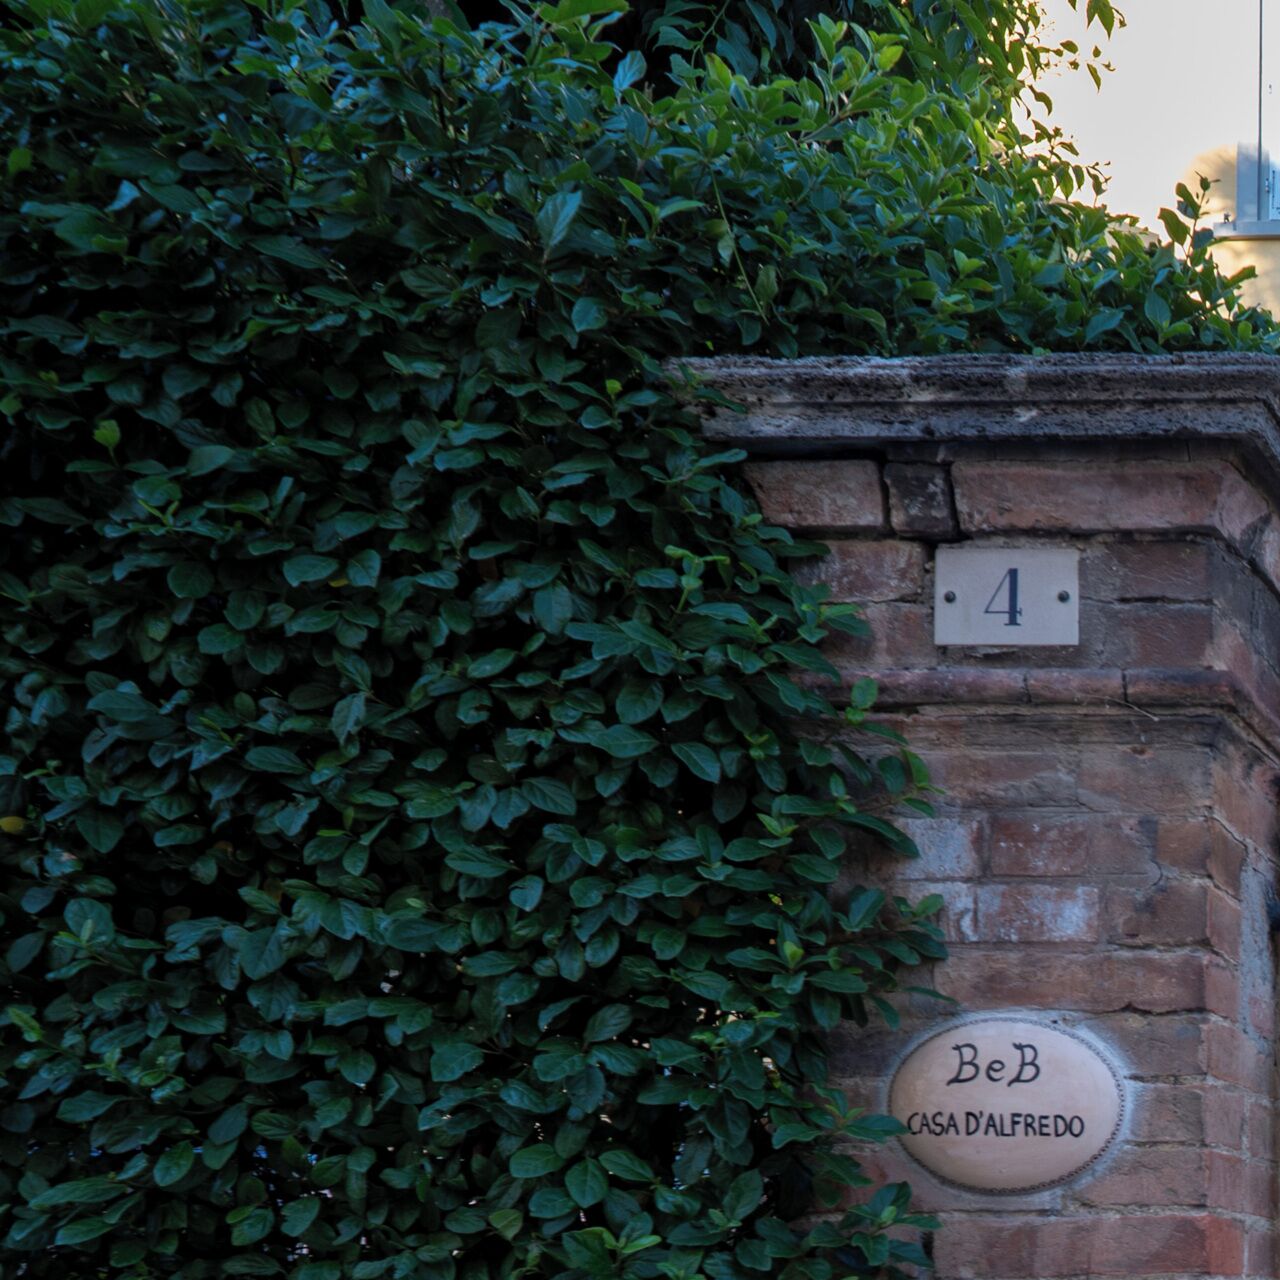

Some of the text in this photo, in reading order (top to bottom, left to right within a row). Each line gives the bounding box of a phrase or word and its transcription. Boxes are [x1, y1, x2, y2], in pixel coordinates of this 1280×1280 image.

[984, 567, 1023, 626] 4
[906, 1110, 1085, 1137] CASA D'ALFREDO
